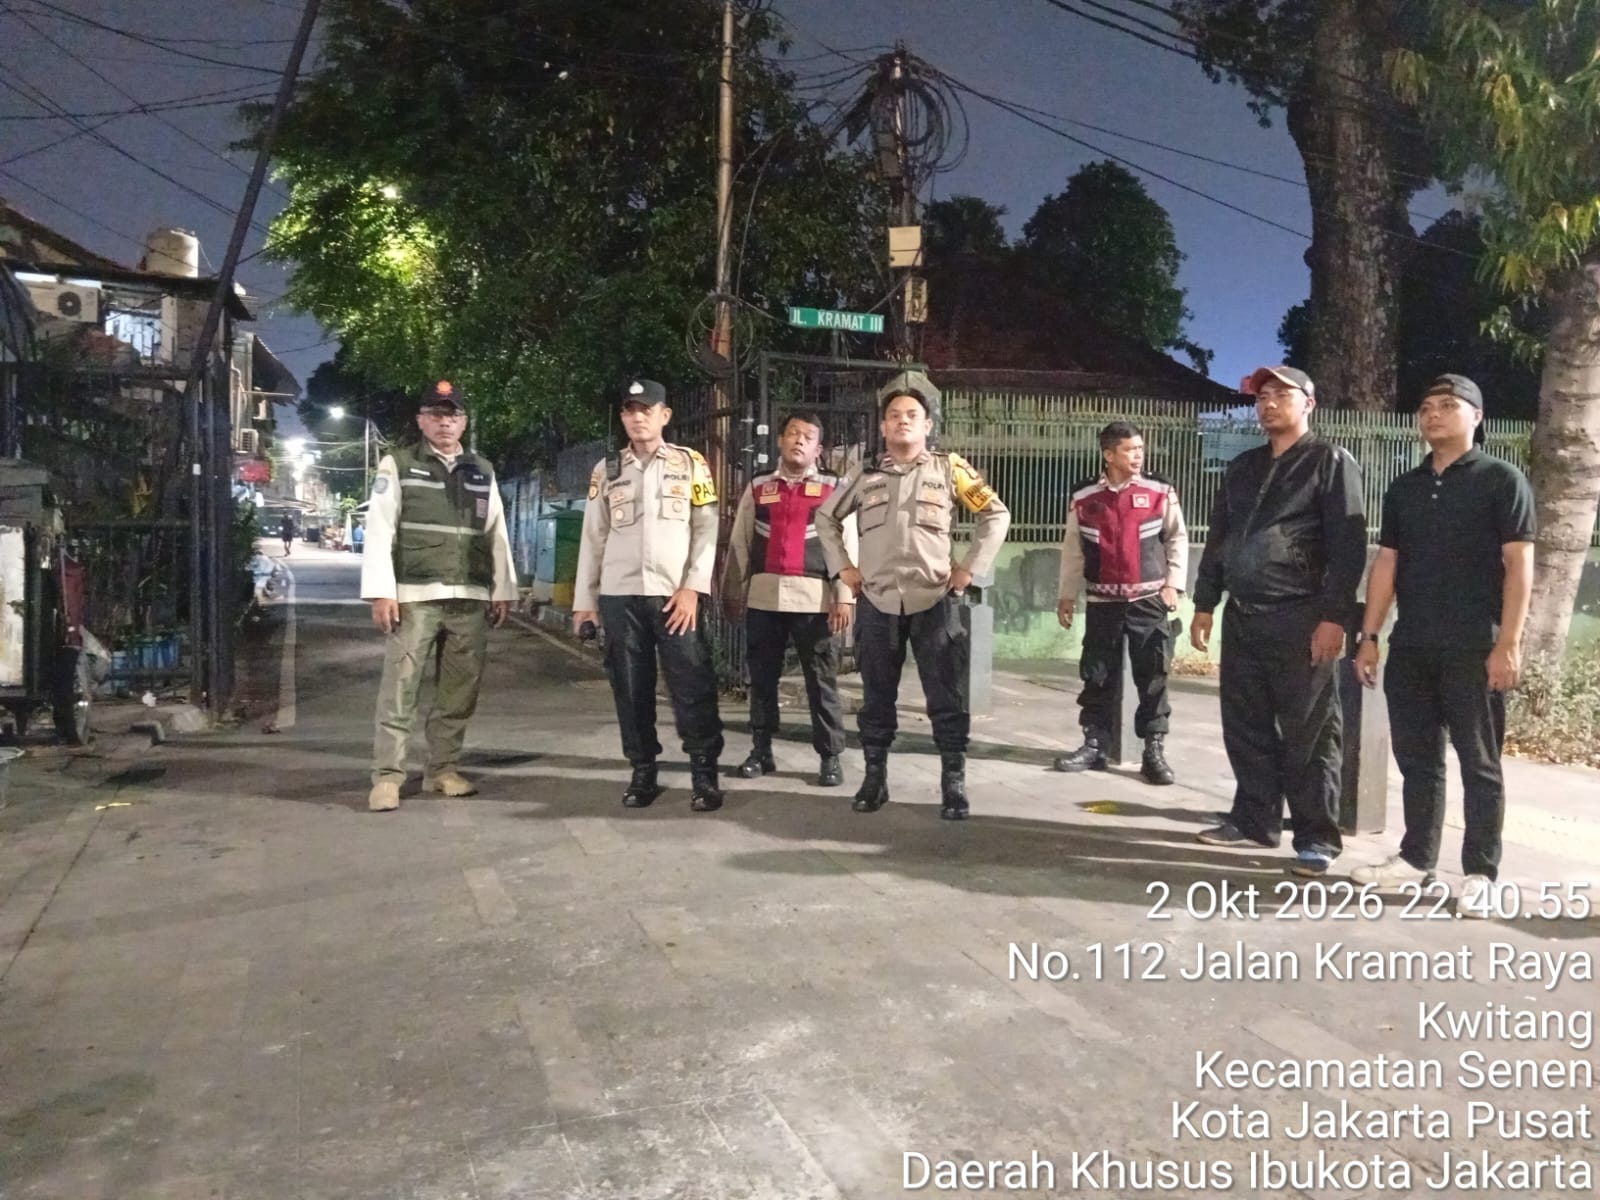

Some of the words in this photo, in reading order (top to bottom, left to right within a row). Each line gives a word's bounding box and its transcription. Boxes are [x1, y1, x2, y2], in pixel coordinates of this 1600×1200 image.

[818, 310, 864, 329] KRAMAT
[870, 316, 884, 331] III
[922, 481, 944, 490] POLRI
